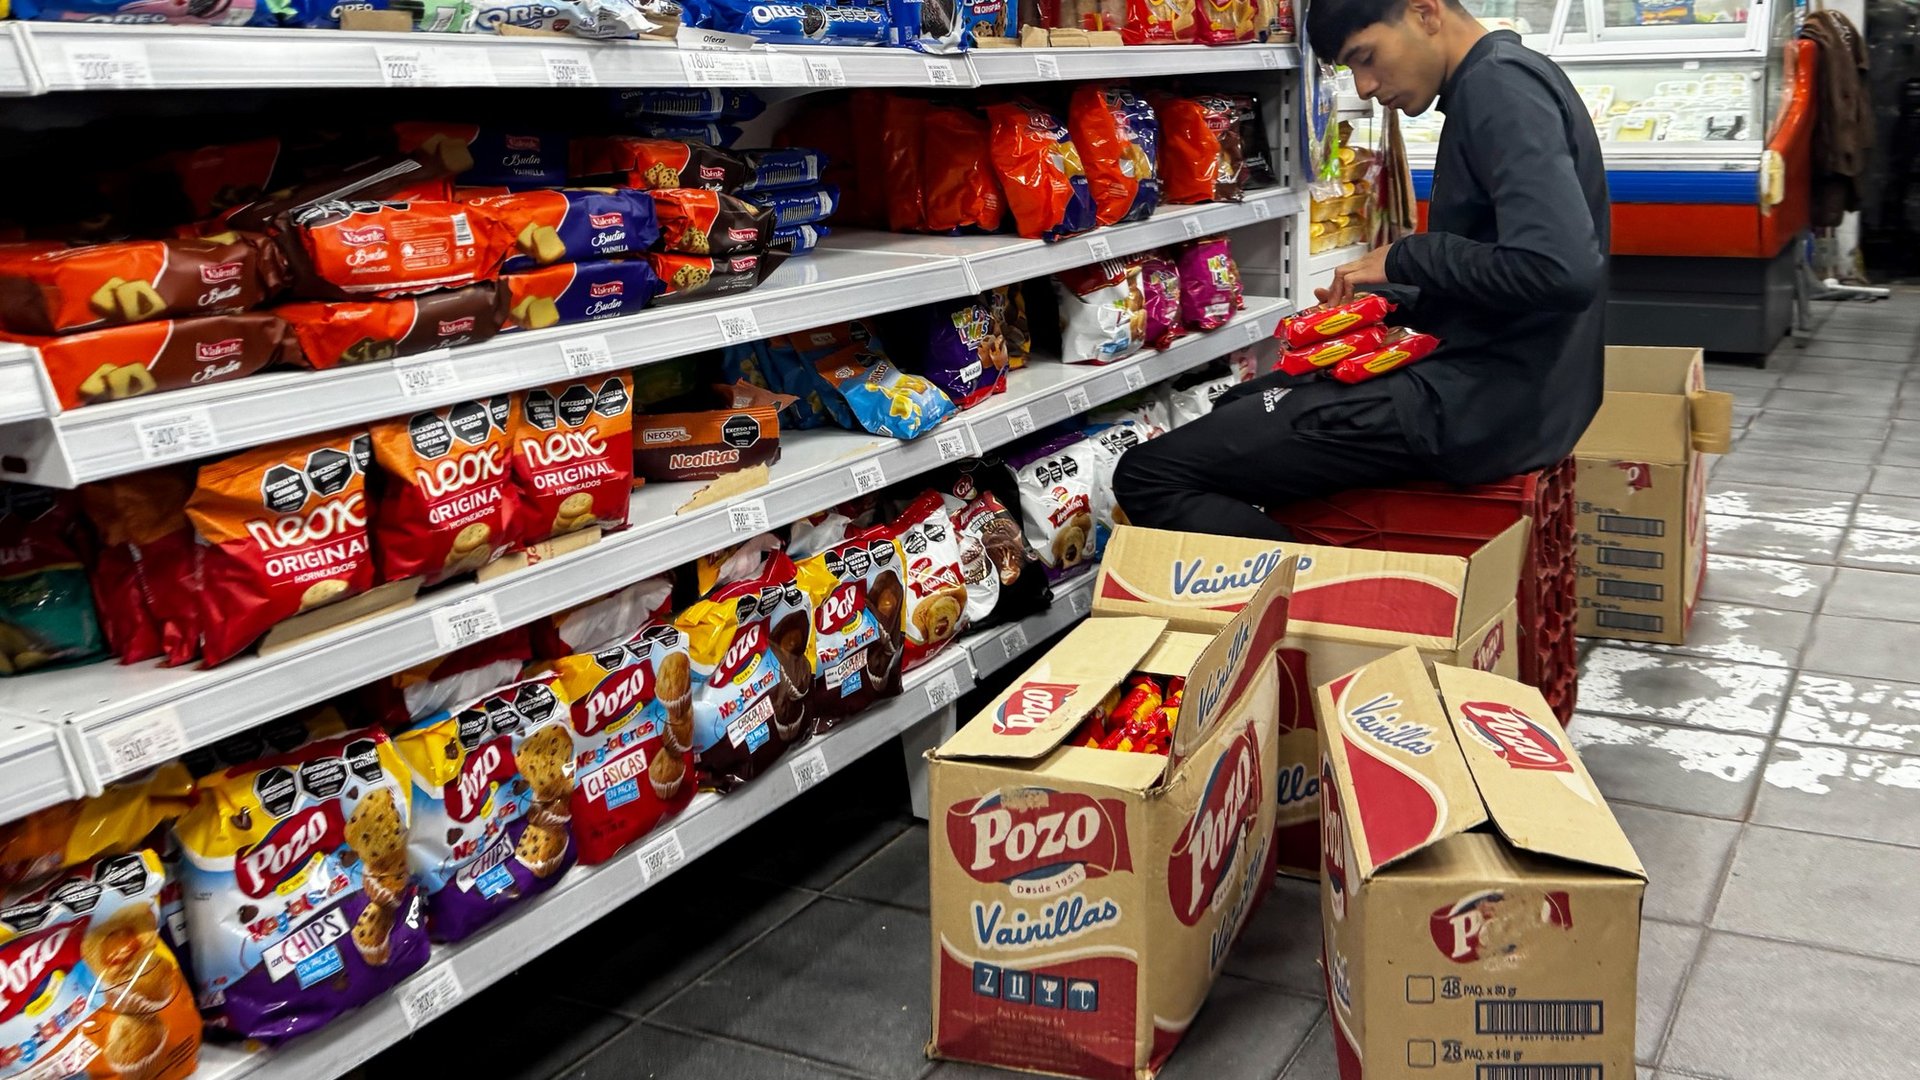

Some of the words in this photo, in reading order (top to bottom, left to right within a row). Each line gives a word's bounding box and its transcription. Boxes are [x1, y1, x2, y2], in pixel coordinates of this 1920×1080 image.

[478, 5, 559, 29] OREO
[752, 4, 807, 24] OREO
[522, 427, 607, 468] neox
[670, 449, 740, 469] Neolitas
[534, 461, 616, 490] ORIGINAL
[555, 479, 602, 496] HORNEADOS
[246, 493, 367, 551] neox
[429, 484, 504, 524] ORIGINA
[576, 720, 655, 769] Magdalenas
[1349, 693, 1436, 756] Vainillas
[587, 753, 646, 797] CLÁSICAS
[469, 836, 513, 880] CHIPS
[1016, 884, 1052, 895] Desde
[1055, 871, 1080, 889] 1951
[282, 913, 342, 965] CHIPS
[975, 896, 1118, 945] Vainillas
[1442, 979, 1461, 995] 48
[1464, 985, 1485, 997] PAQ.
[1508, 987, 1517, 998] gr
[1443, 1043, 1462, 1060] 28
[1464, 1049, 1486, 1061] PAQ.
[1488, 1051, 1494, 1059] x
[1514, 1051, 1523, 1061] gr
